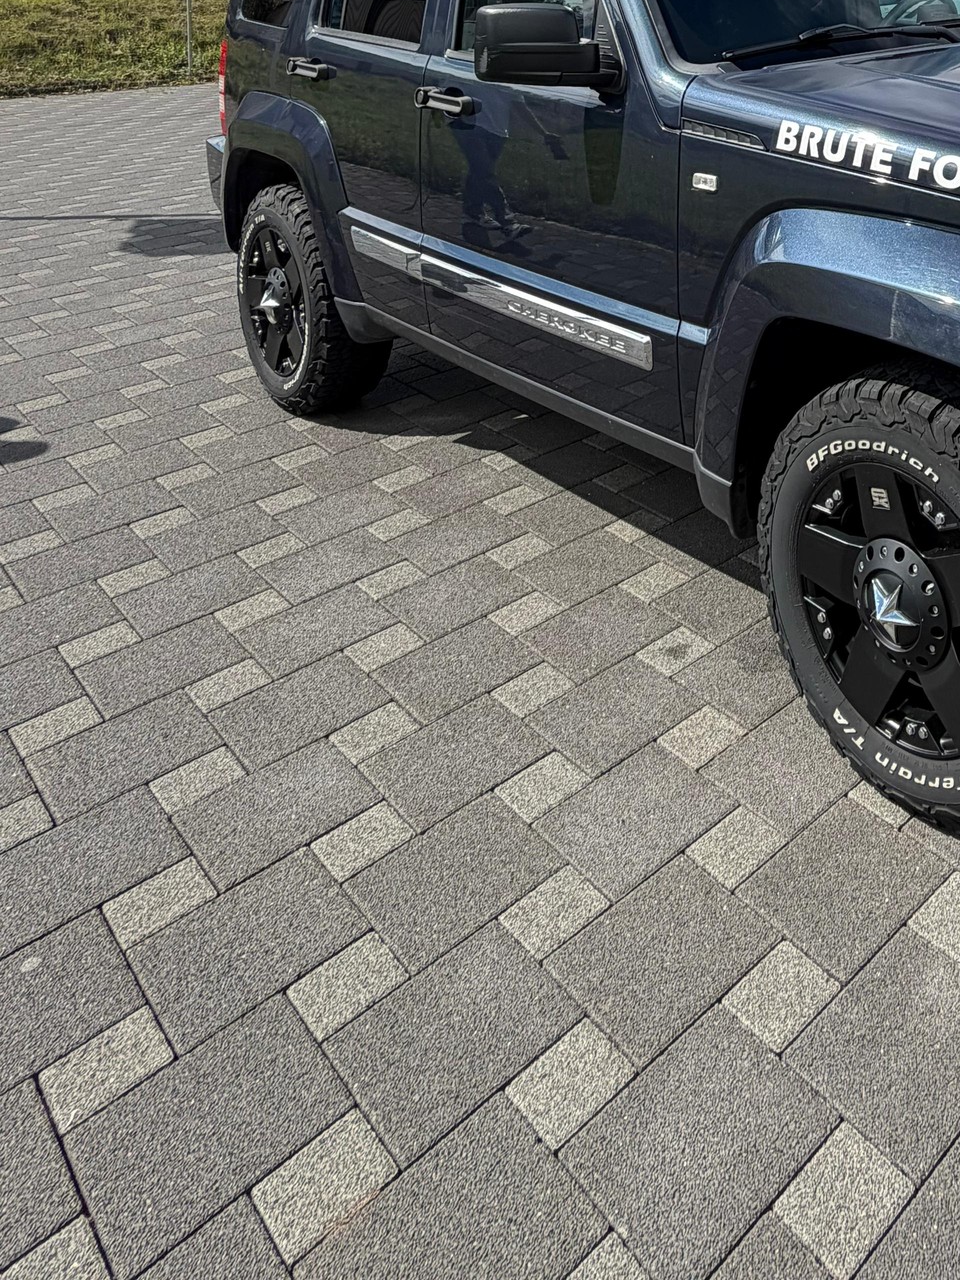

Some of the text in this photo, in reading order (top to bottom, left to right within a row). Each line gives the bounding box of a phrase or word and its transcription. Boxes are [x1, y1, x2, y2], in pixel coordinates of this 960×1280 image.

[775, 119, 901, 175] BRUTE
[507, 300, 626, 353] CHEROKEE
[806, 440, 939, 483] BFGoodrich
[832, 707, 865, 751] T/A
